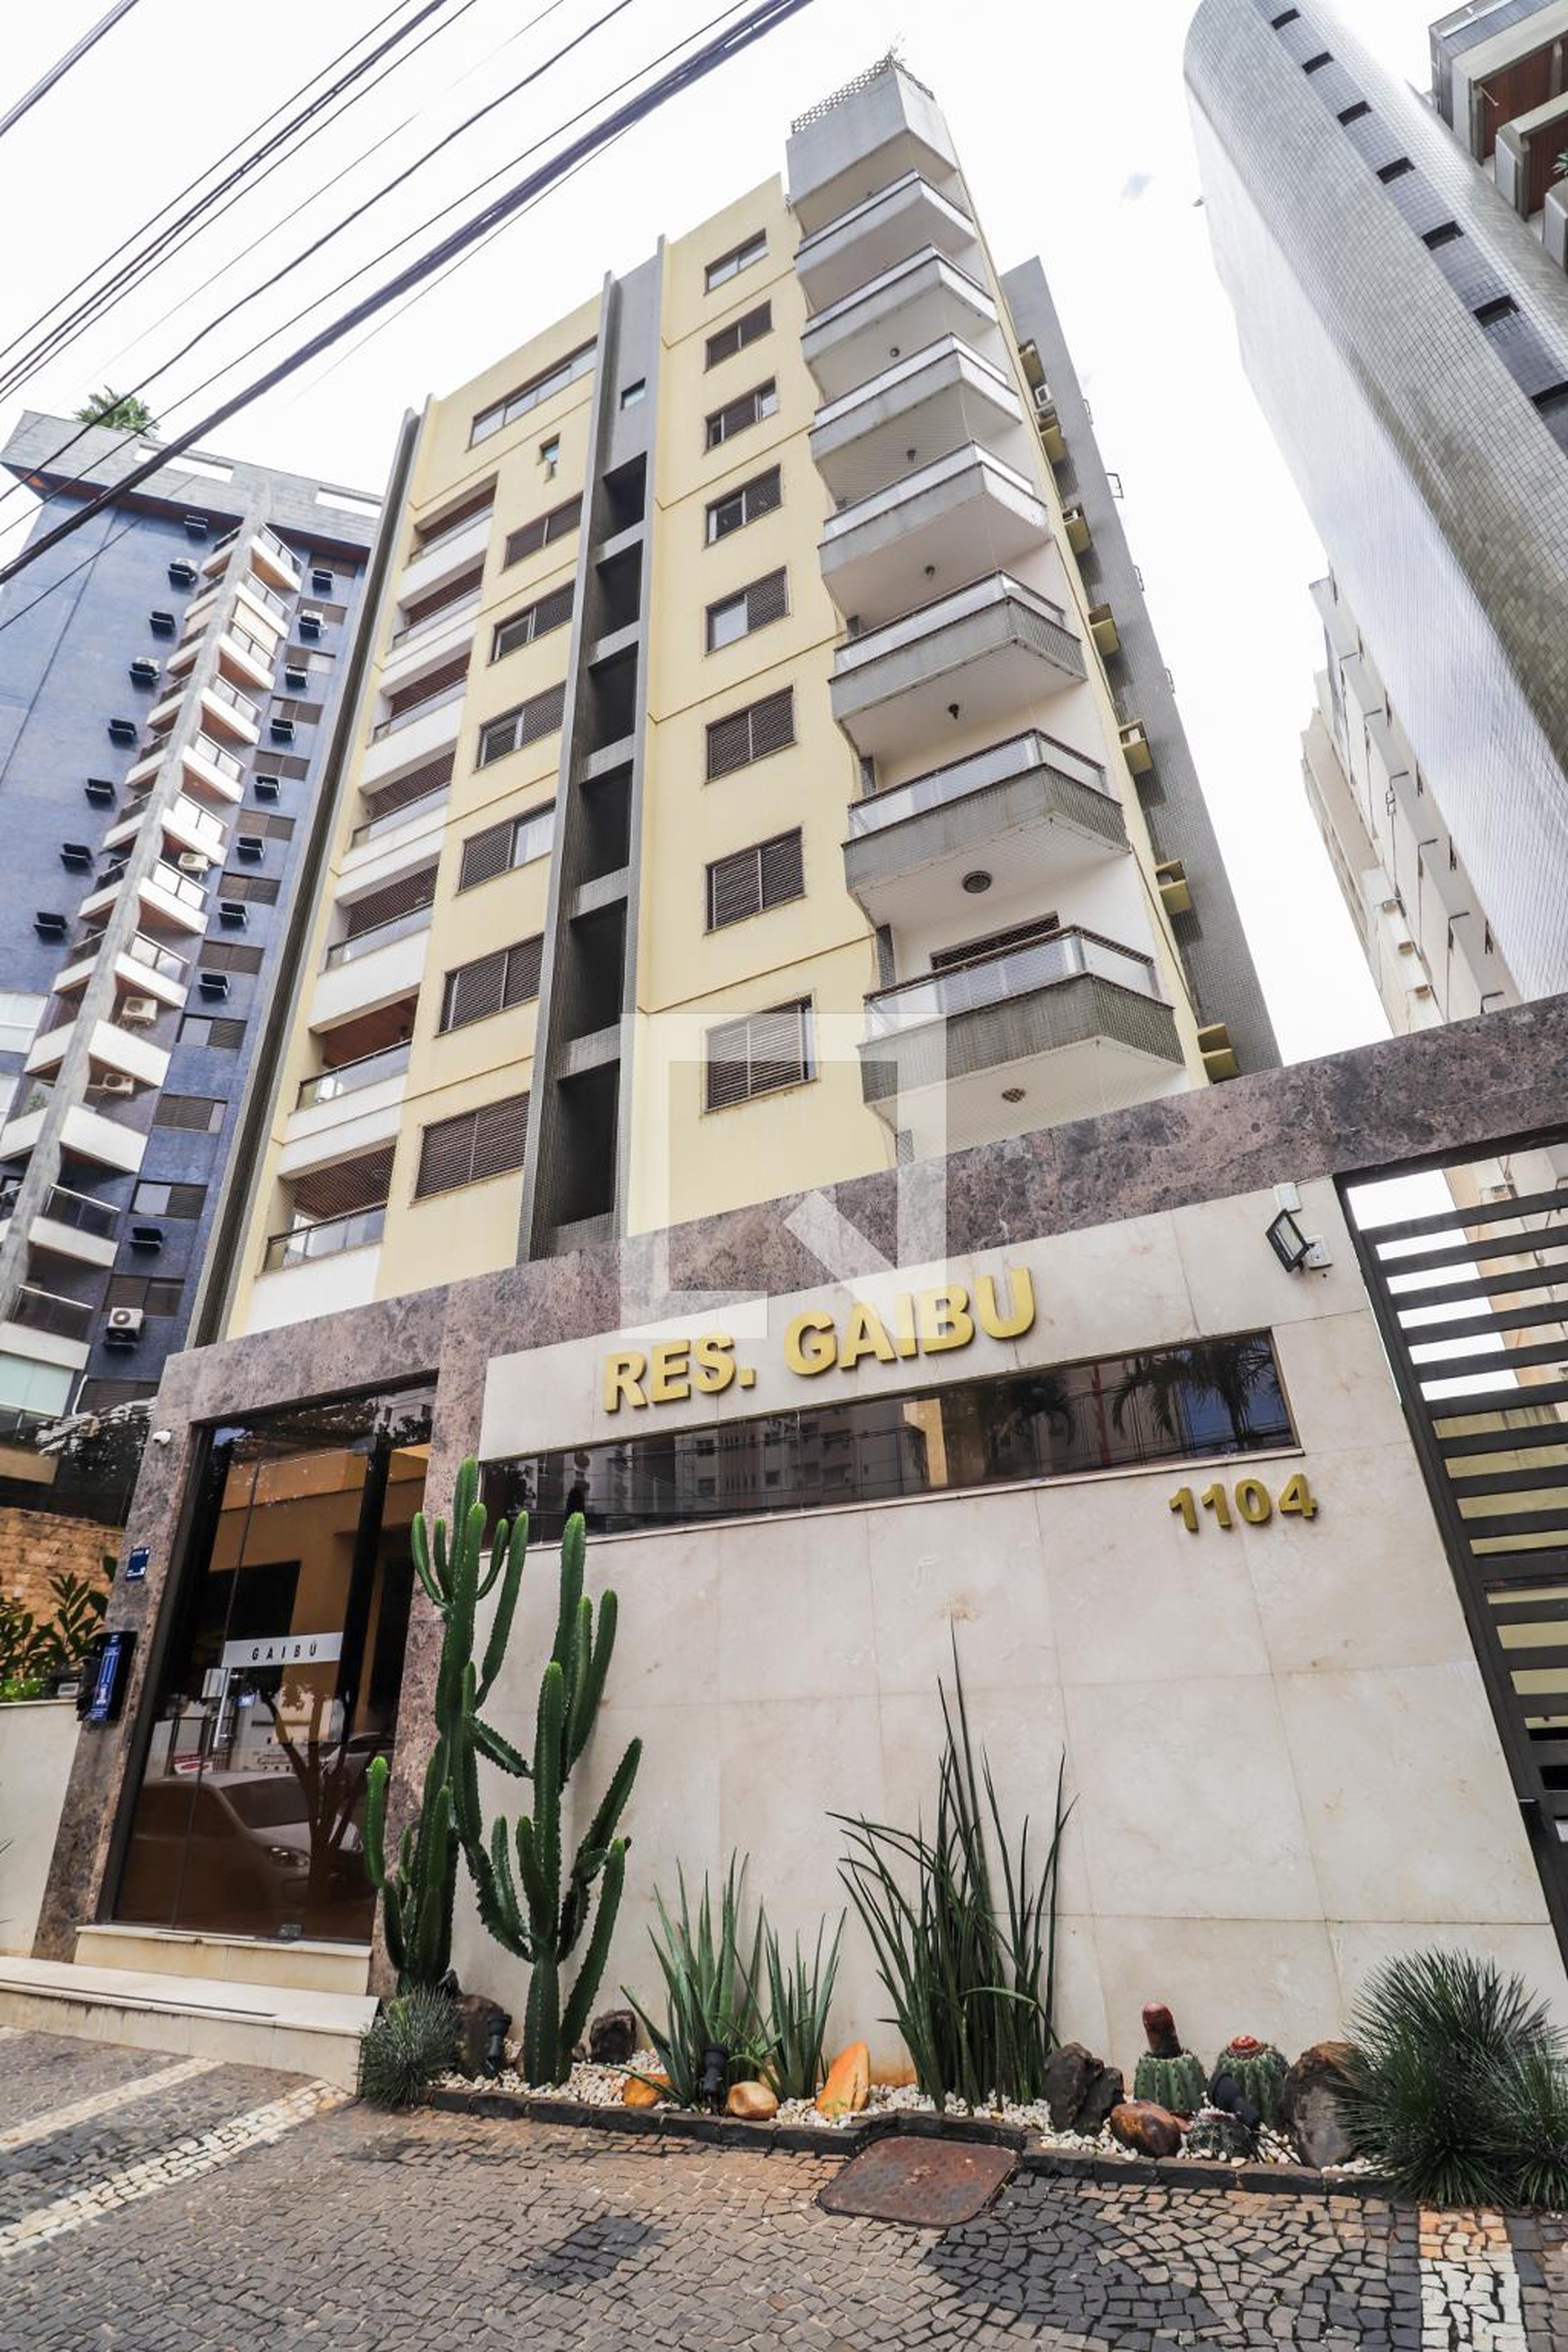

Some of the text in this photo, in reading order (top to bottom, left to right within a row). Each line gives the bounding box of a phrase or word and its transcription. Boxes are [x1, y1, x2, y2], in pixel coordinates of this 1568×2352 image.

[604, 1267, 1036, 1413] RES. GAIBU
[1169, 1472, 1318, 1532] 1104
